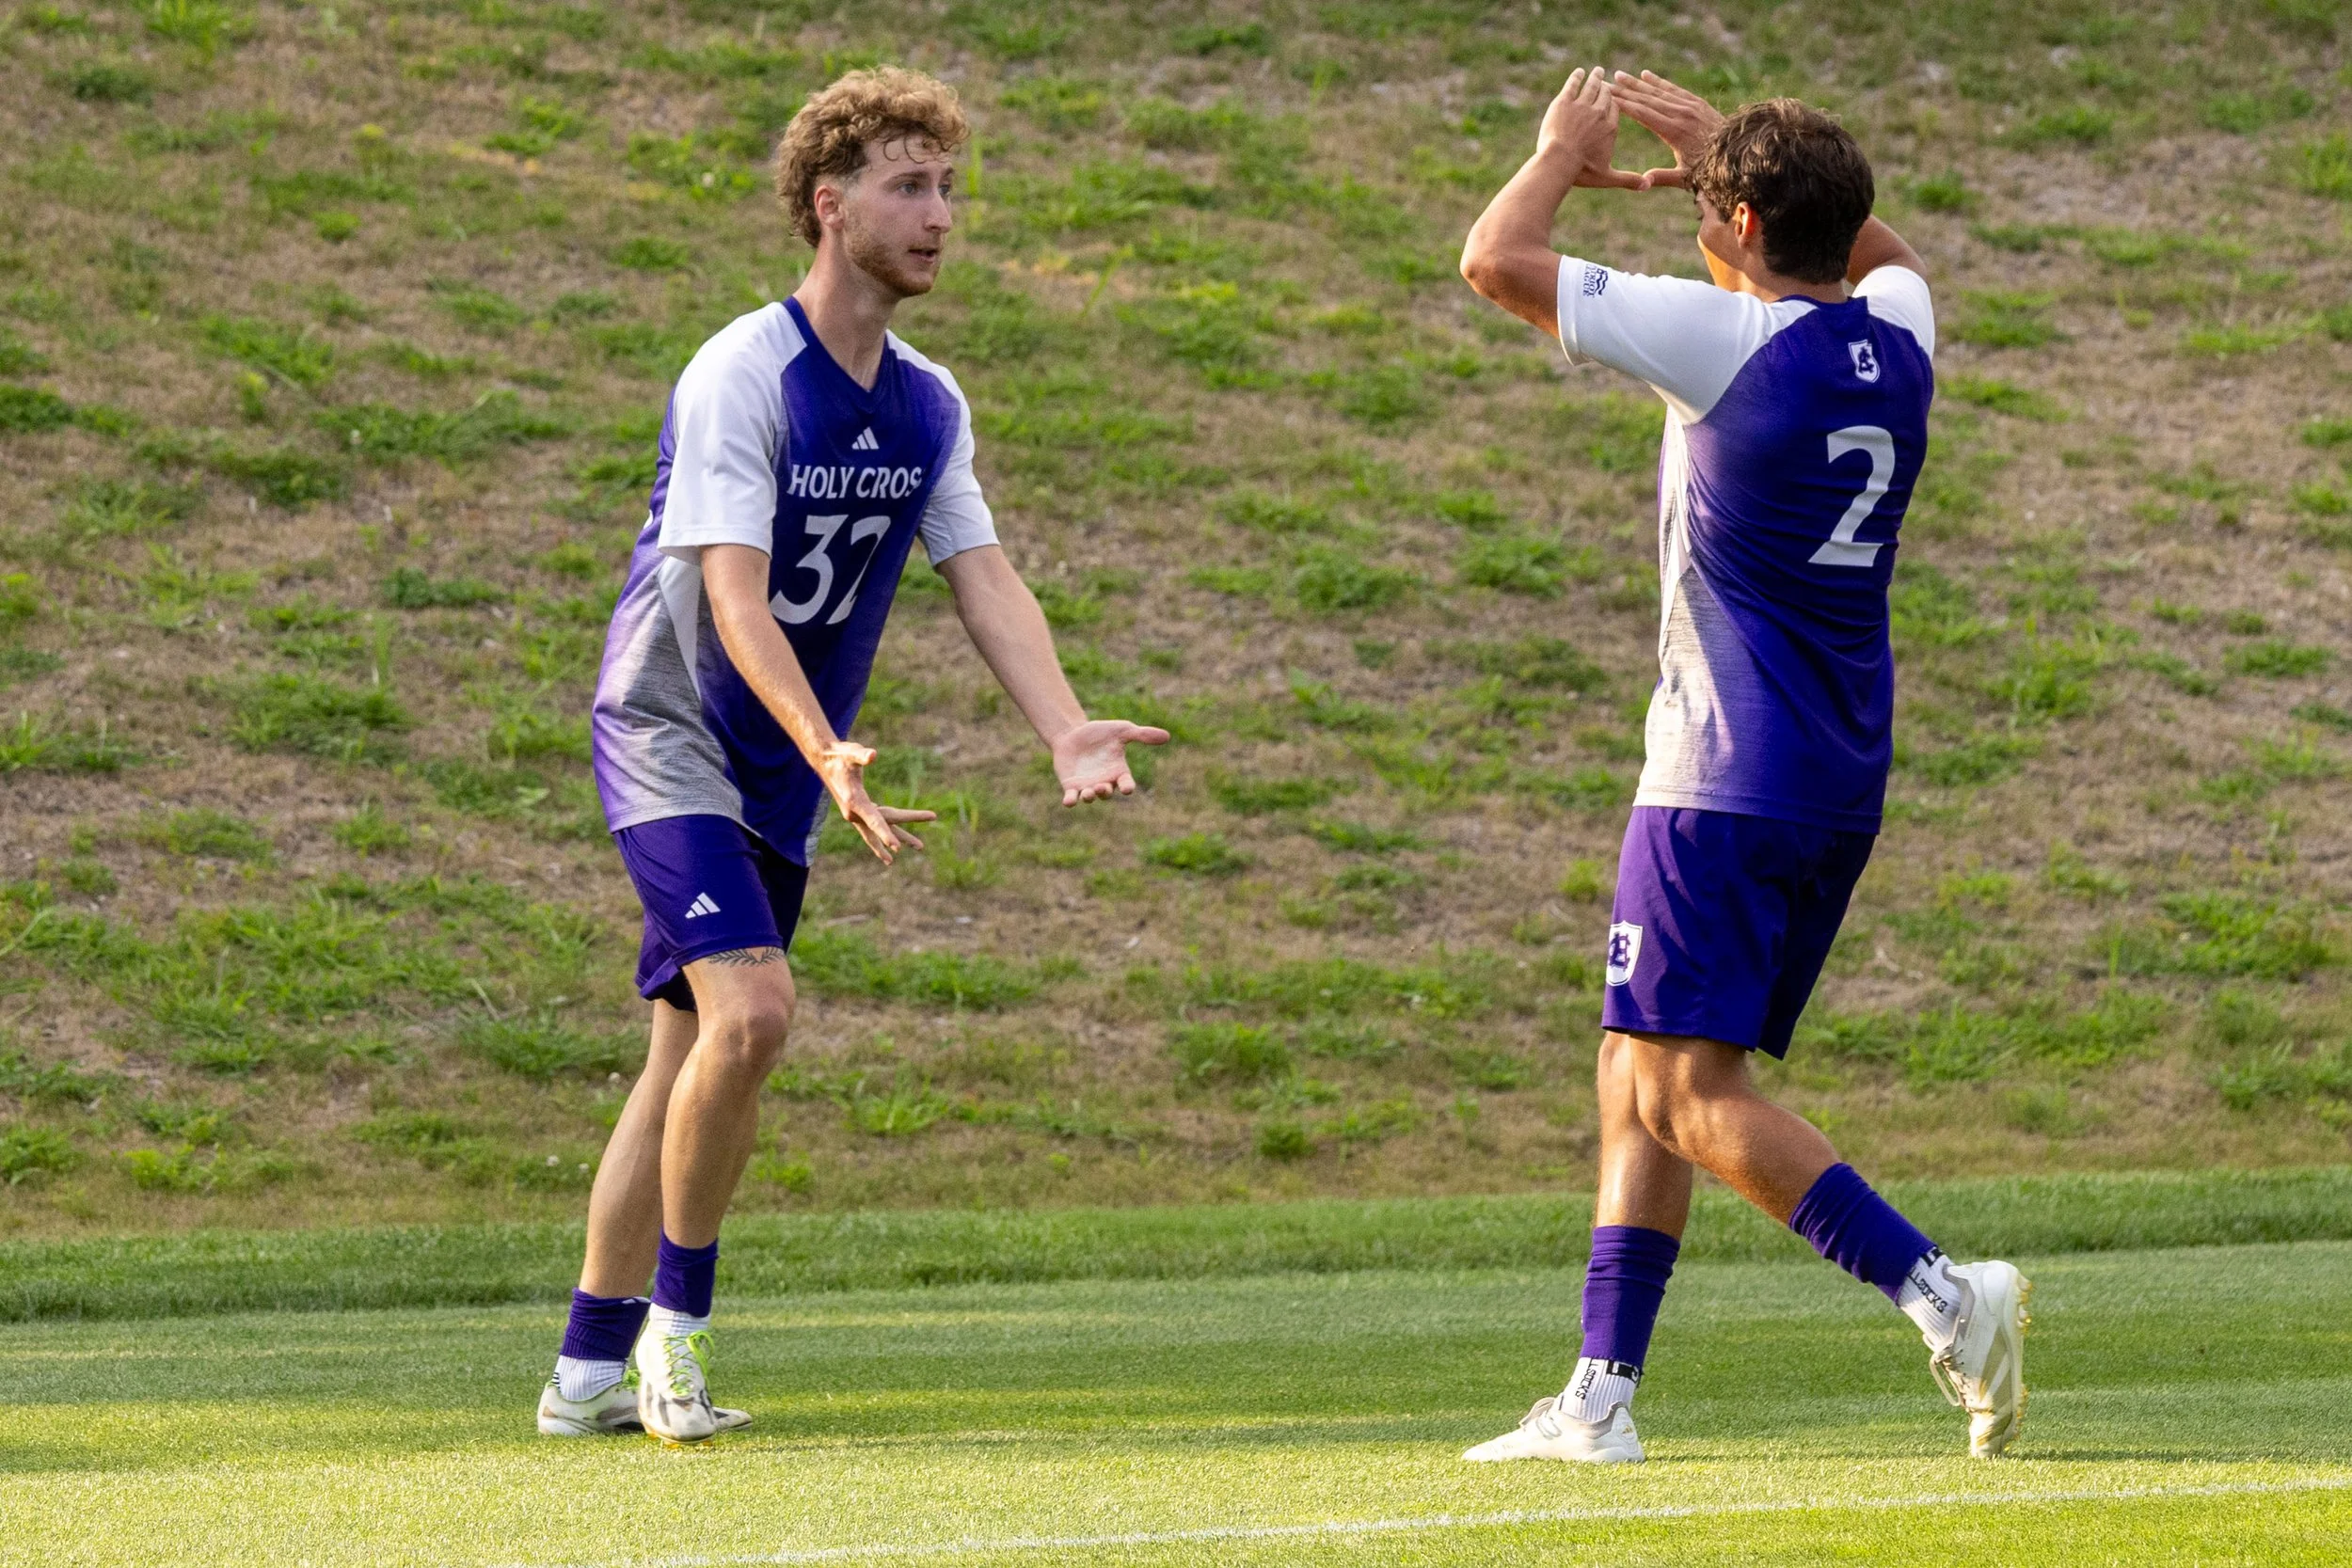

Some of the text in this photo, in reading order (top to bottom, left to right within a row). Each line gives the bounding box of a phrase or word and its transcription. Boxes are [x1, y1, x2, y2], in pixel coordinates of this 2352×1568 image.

[787, 464, 924, 499] HOLY CROS
[1807, 425, 1896, 568] 2
[770, 514, 892, 626] 32
[1575, 1357, 1599, 1400] LSOCKS
